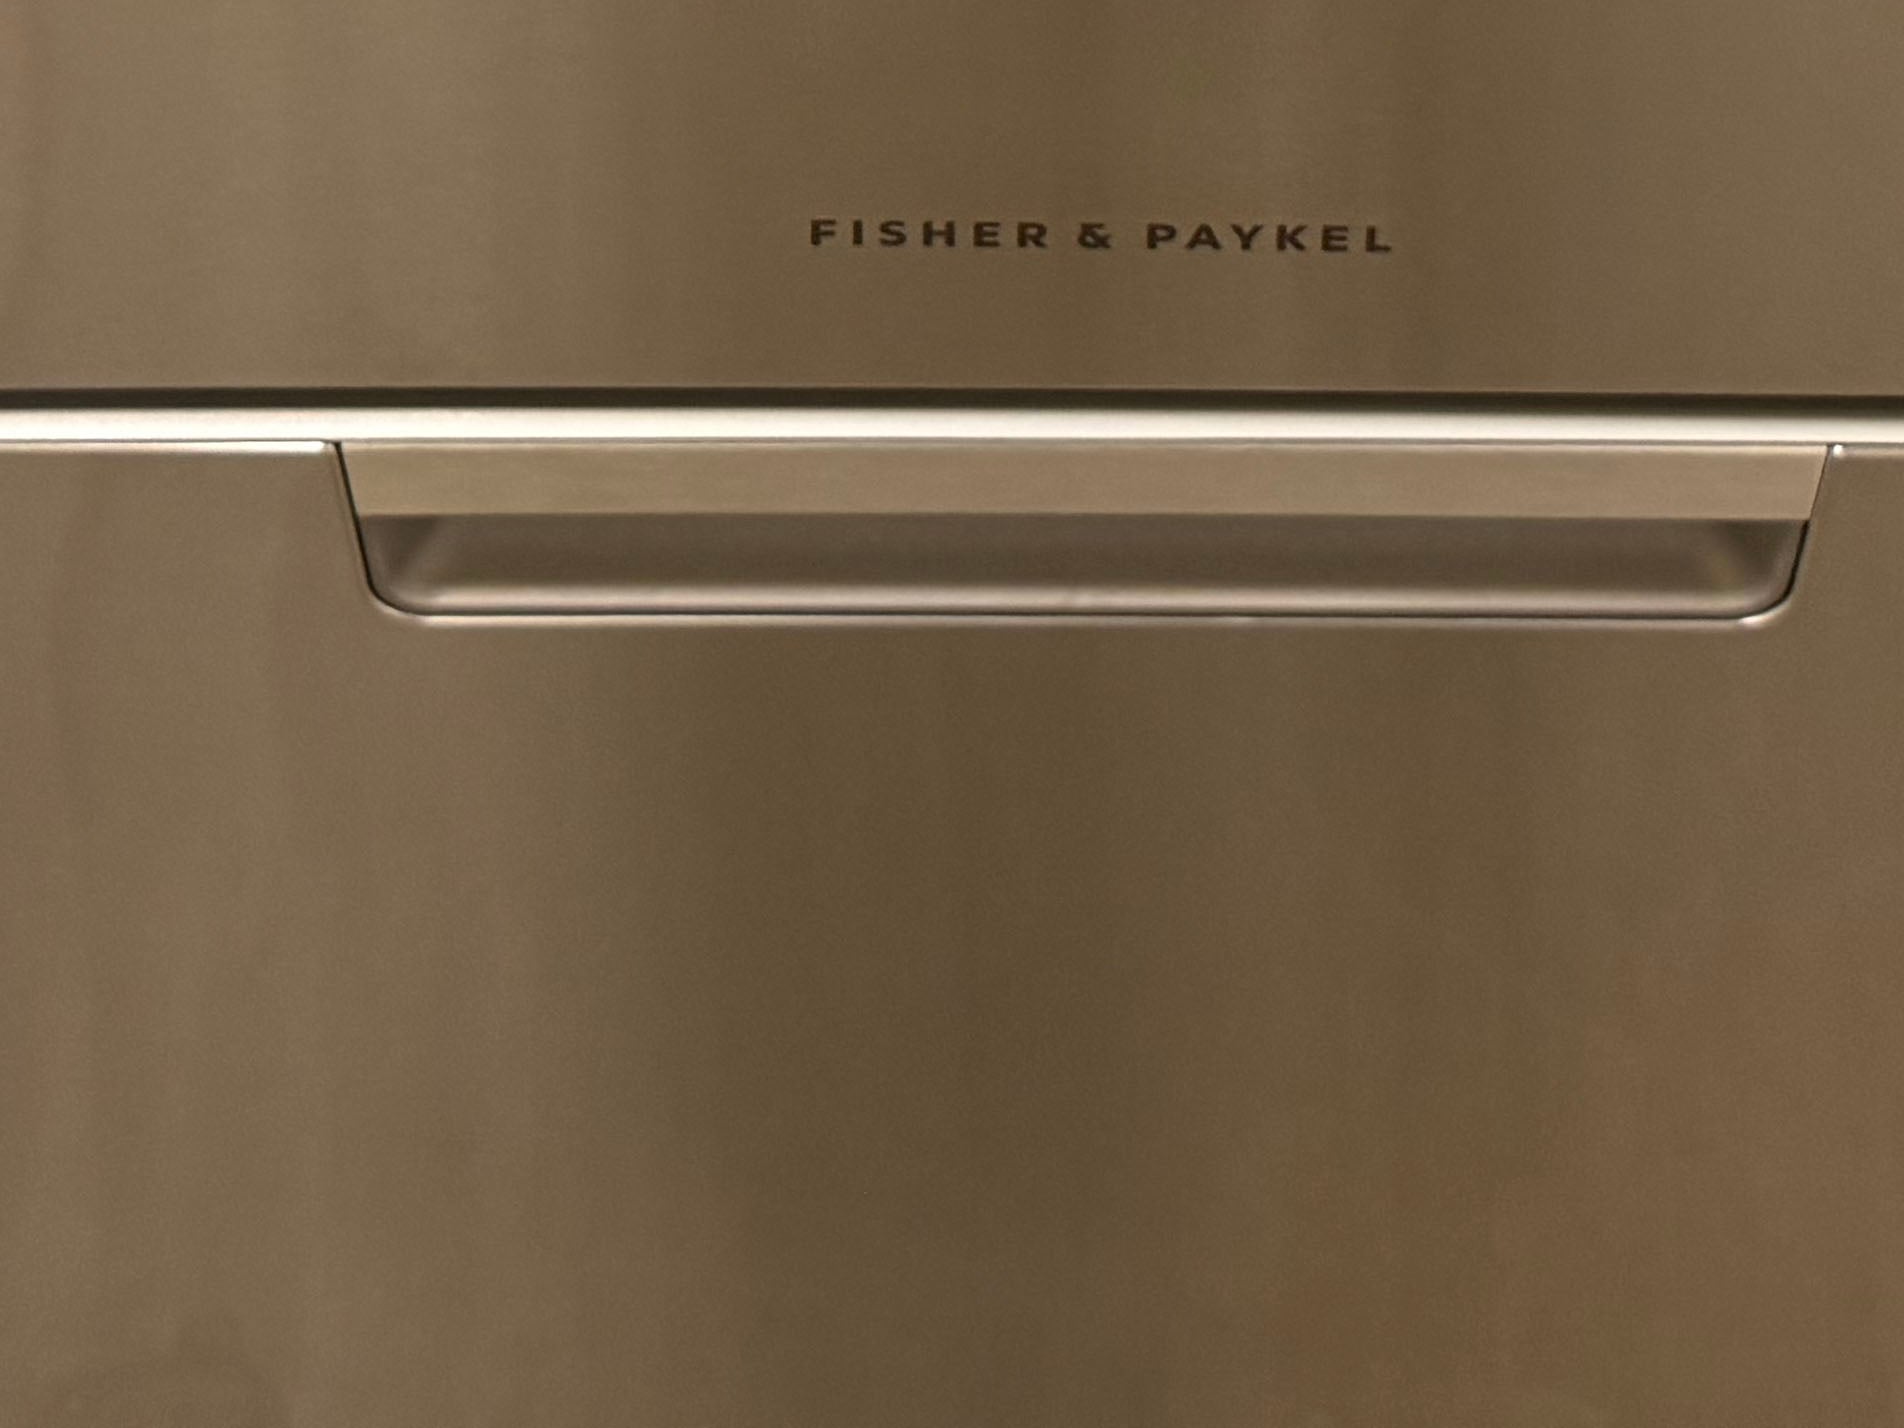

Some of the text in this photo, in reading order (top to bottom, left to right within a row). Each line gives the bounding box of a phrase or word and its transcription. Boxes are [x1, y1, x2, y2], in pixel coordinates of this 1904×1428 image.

[809, 219, 1393, 253] FISHER & PAYKEL
